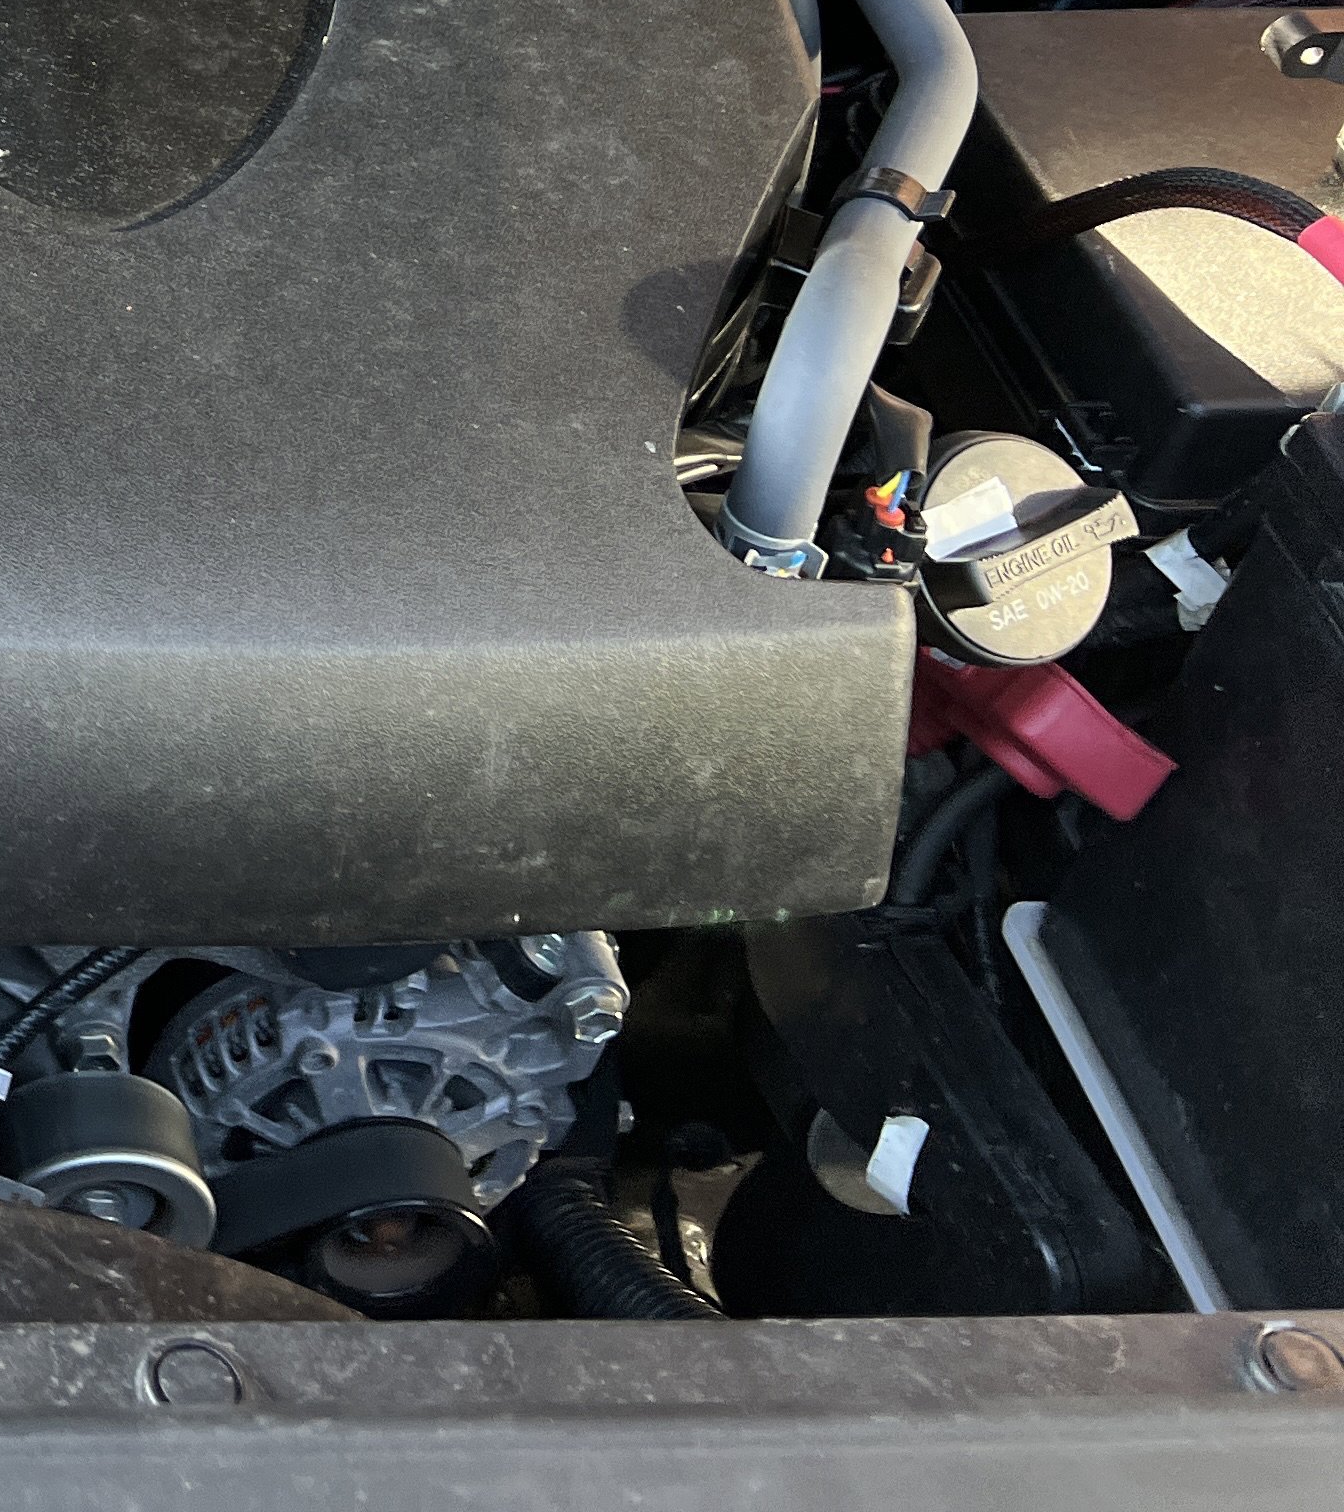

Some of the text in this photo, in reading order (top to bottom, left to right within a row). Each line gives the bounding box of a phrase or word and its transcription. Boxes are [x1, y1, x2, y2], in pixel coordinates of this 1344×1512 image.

[984, 533, 1080, 589] ENGINE OIL
[989, 598, 1030, 632] SAE
